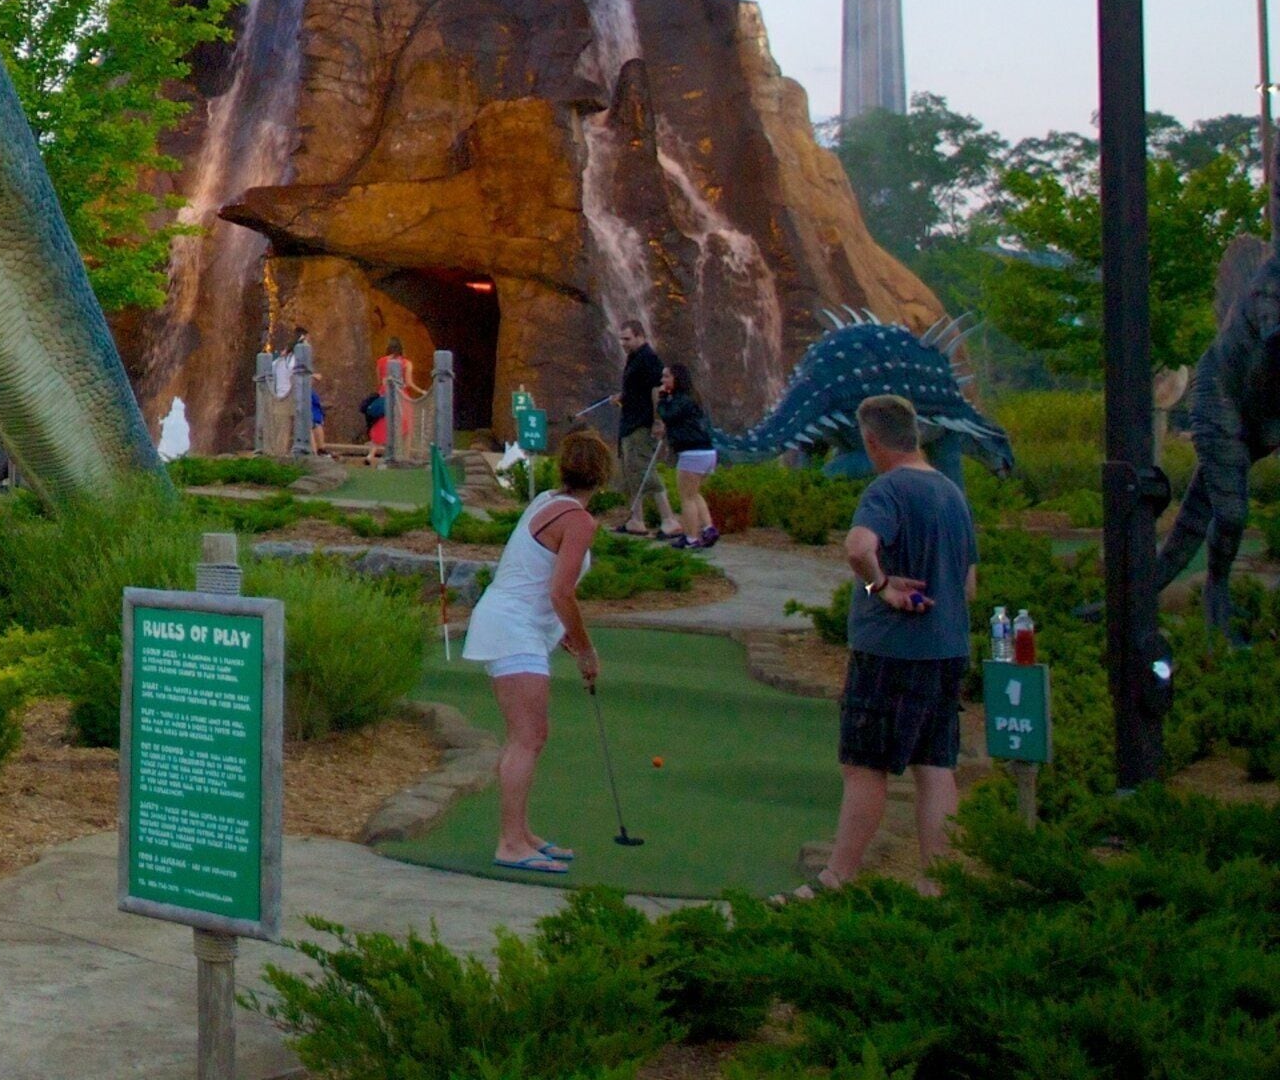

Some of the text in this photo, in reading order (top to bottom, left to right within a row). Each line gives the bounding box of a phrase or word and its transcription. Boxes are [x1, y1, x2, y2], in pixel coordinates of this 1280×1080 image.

[143, 620, 251, 649] RULES OF PLAY
[1004, 680, 1021, 706] 1
[995, 716, 1033, 734] PAR
[1009, 735, 1021, 750] 3
